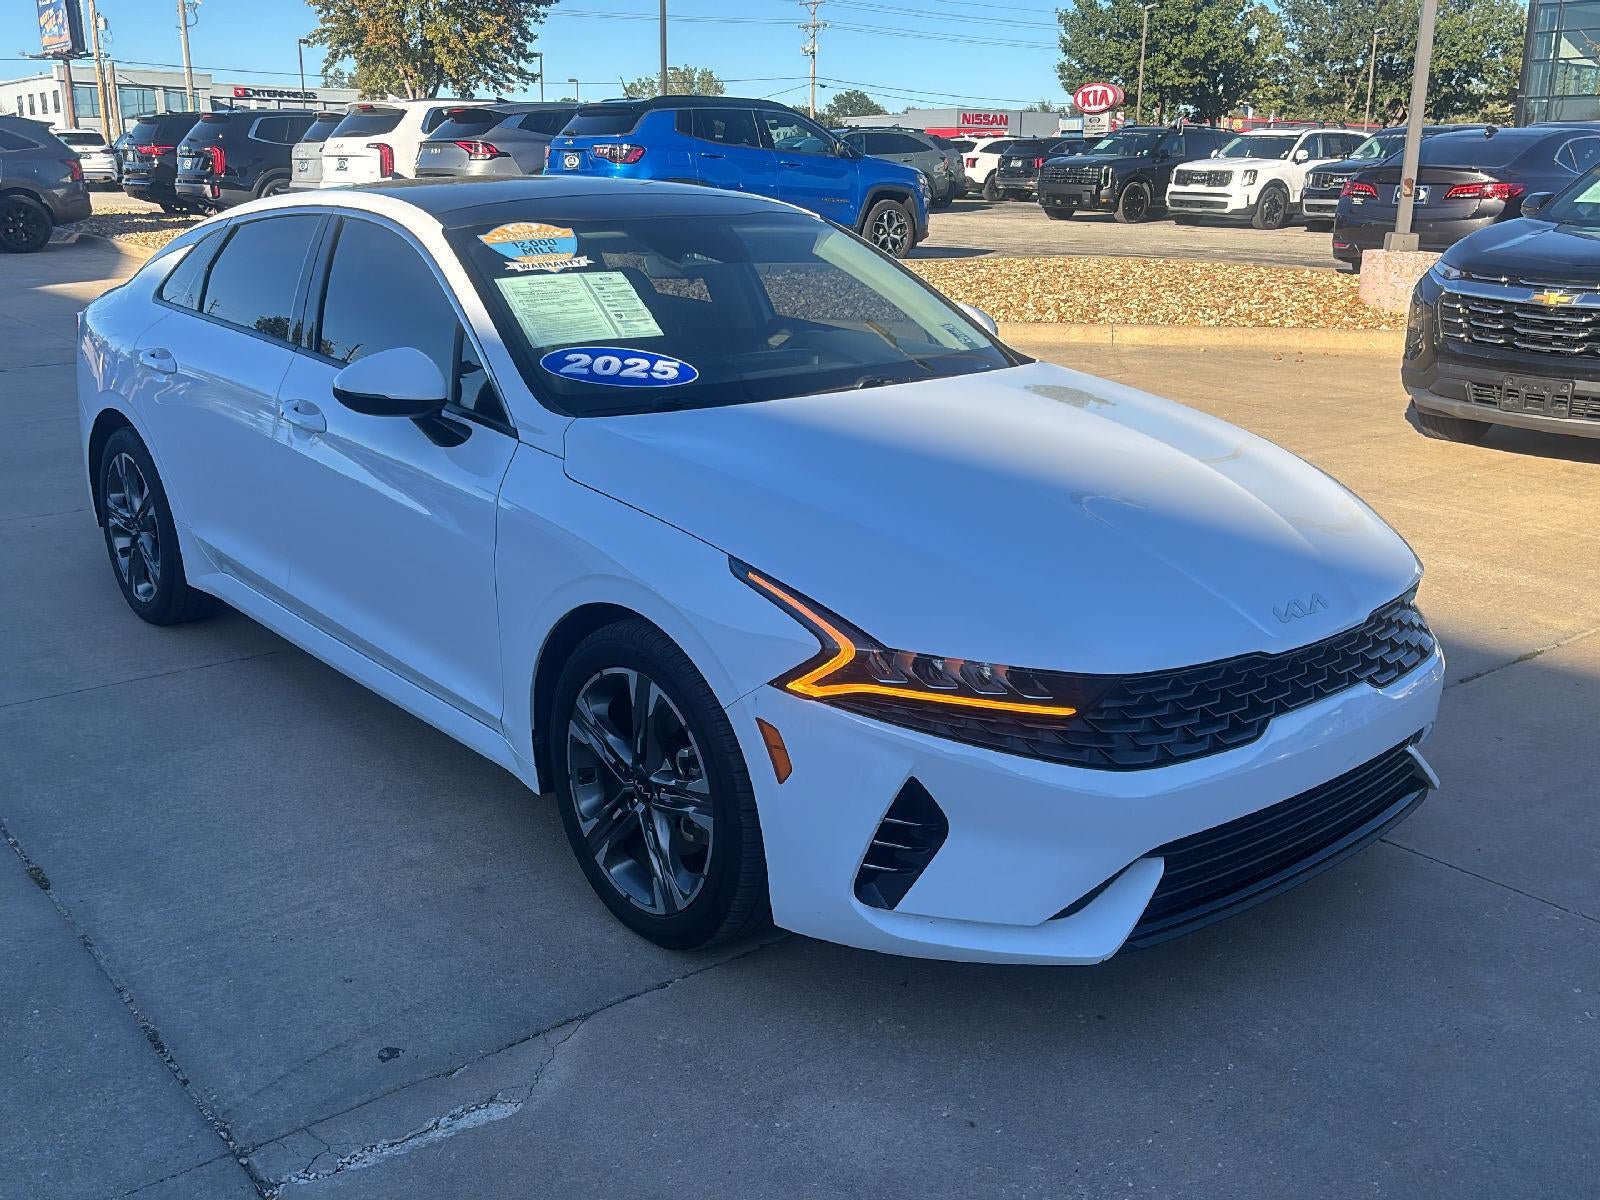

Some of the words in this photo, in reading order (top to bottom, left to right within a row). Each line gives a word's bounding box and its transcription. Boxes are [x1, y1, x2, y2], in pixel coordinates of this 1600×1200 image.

[1081, 89, 1110, 108] KIA
[961, 113, 1009, 126] NISSAN
[521, 245, 559, 256] MILE
[518, 259, 582, 270] WARRANTY
[559, 353, 681, 380] 2025
[1272, 592, 1328, 623] KIA
